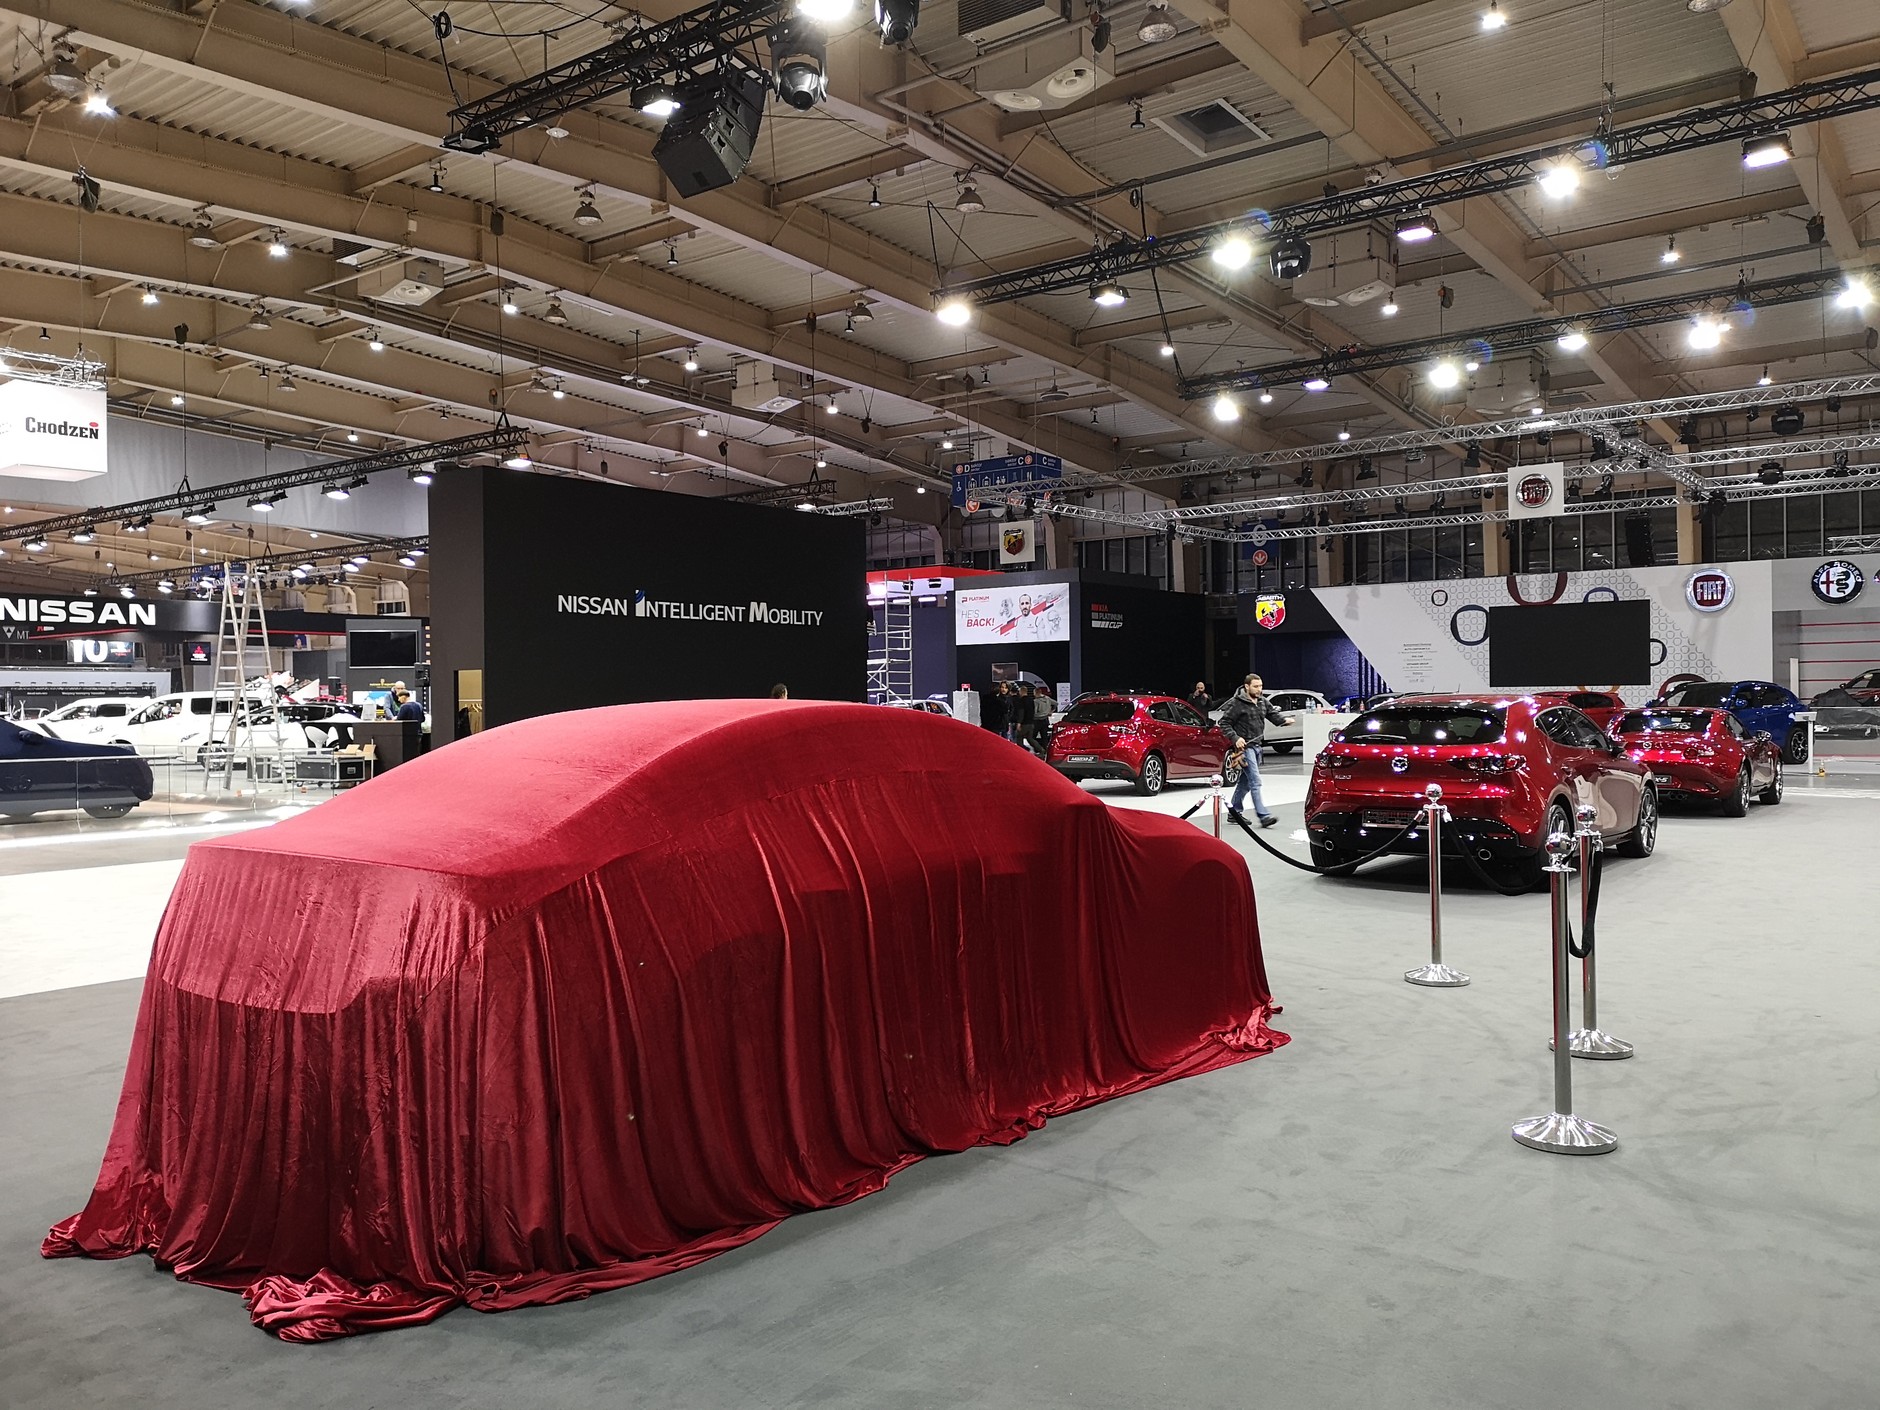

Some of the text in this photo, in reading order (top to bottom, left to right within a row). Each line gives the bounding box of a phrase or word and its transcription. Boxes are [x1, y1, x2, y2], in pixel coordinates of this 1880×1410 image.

[964, 464, 971, 473] D
[1017, 456, 1024, 465] C
[1833, 561, 1863, 583] ROMEO
[1696, 580, 1724, 601] FIAT
[0, 598, 156, 626] NISSAN
[557, 589, 824, 626] NISSAN INTELLIGENT MOBILITY
[966, 617, 995, 628] BACK!
[1108, 621, 1123, 629] CUP
